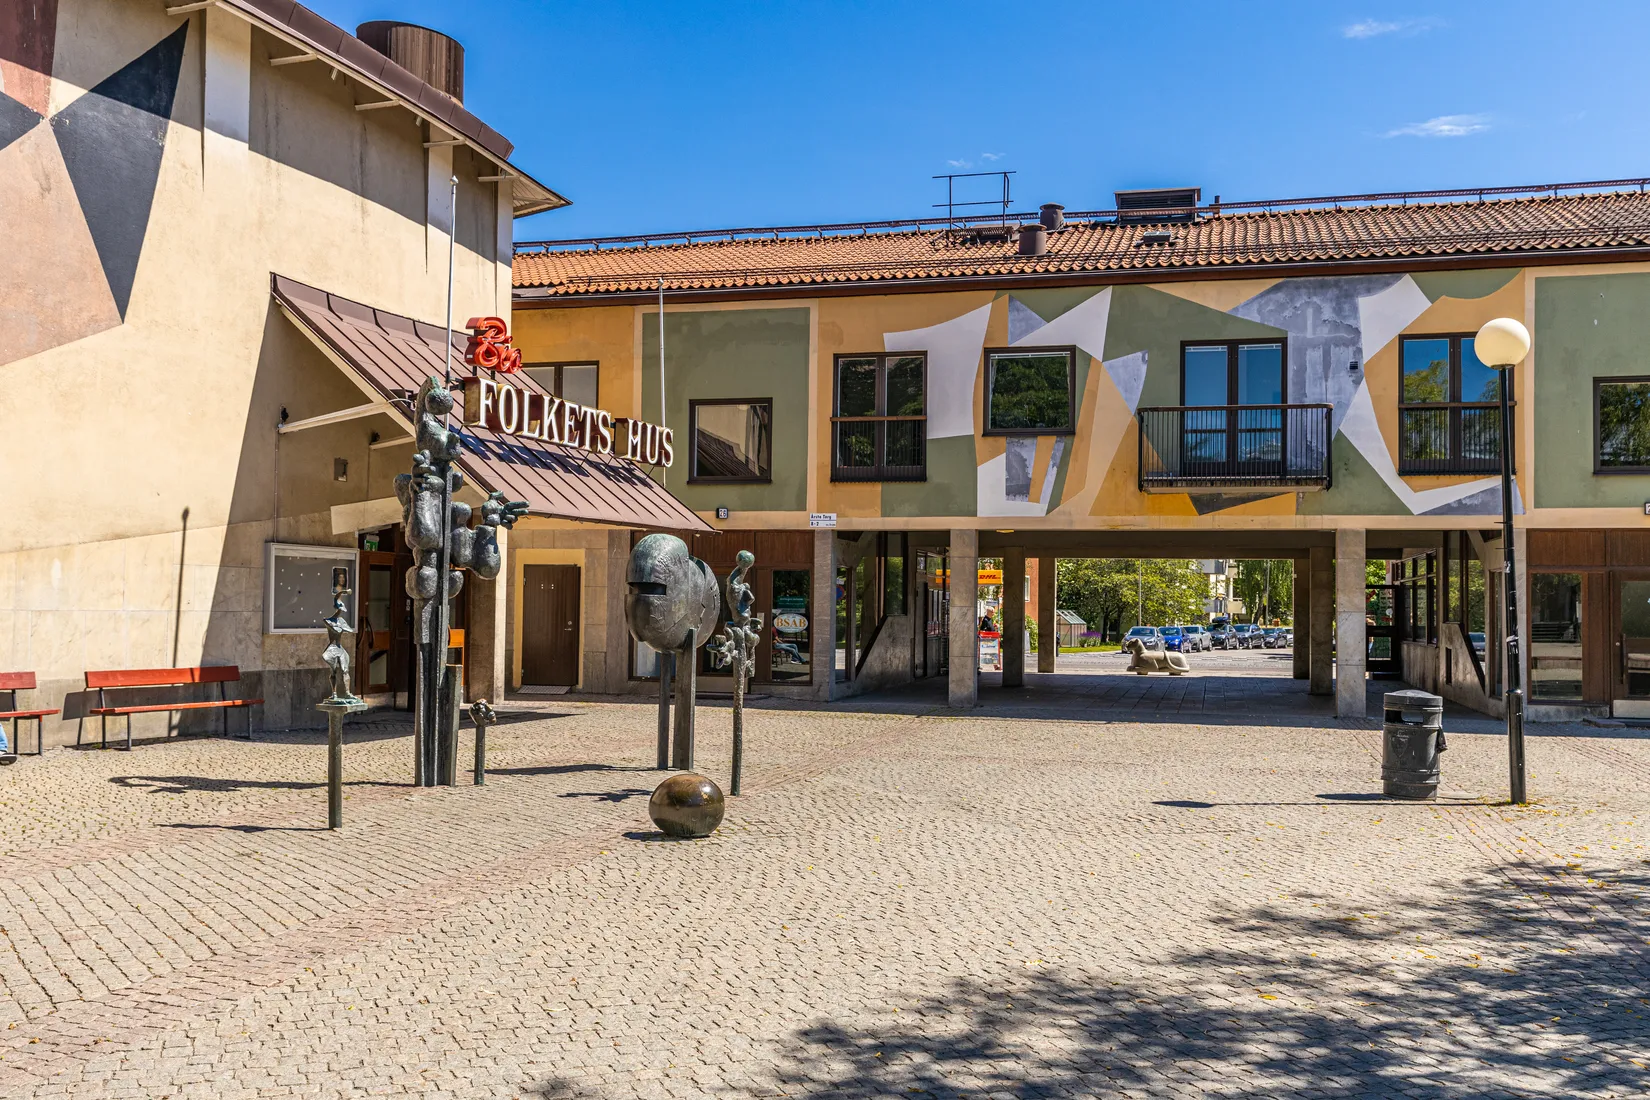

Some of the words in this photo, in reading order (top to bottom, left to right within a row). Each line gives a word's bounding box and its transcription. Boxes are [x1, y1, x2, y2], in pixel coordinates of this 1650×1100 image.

[478, 377, 612, 454] FOLKETS
[626, 417, 674, 468] HUS
[776, 618, 807, 628] BSAB
